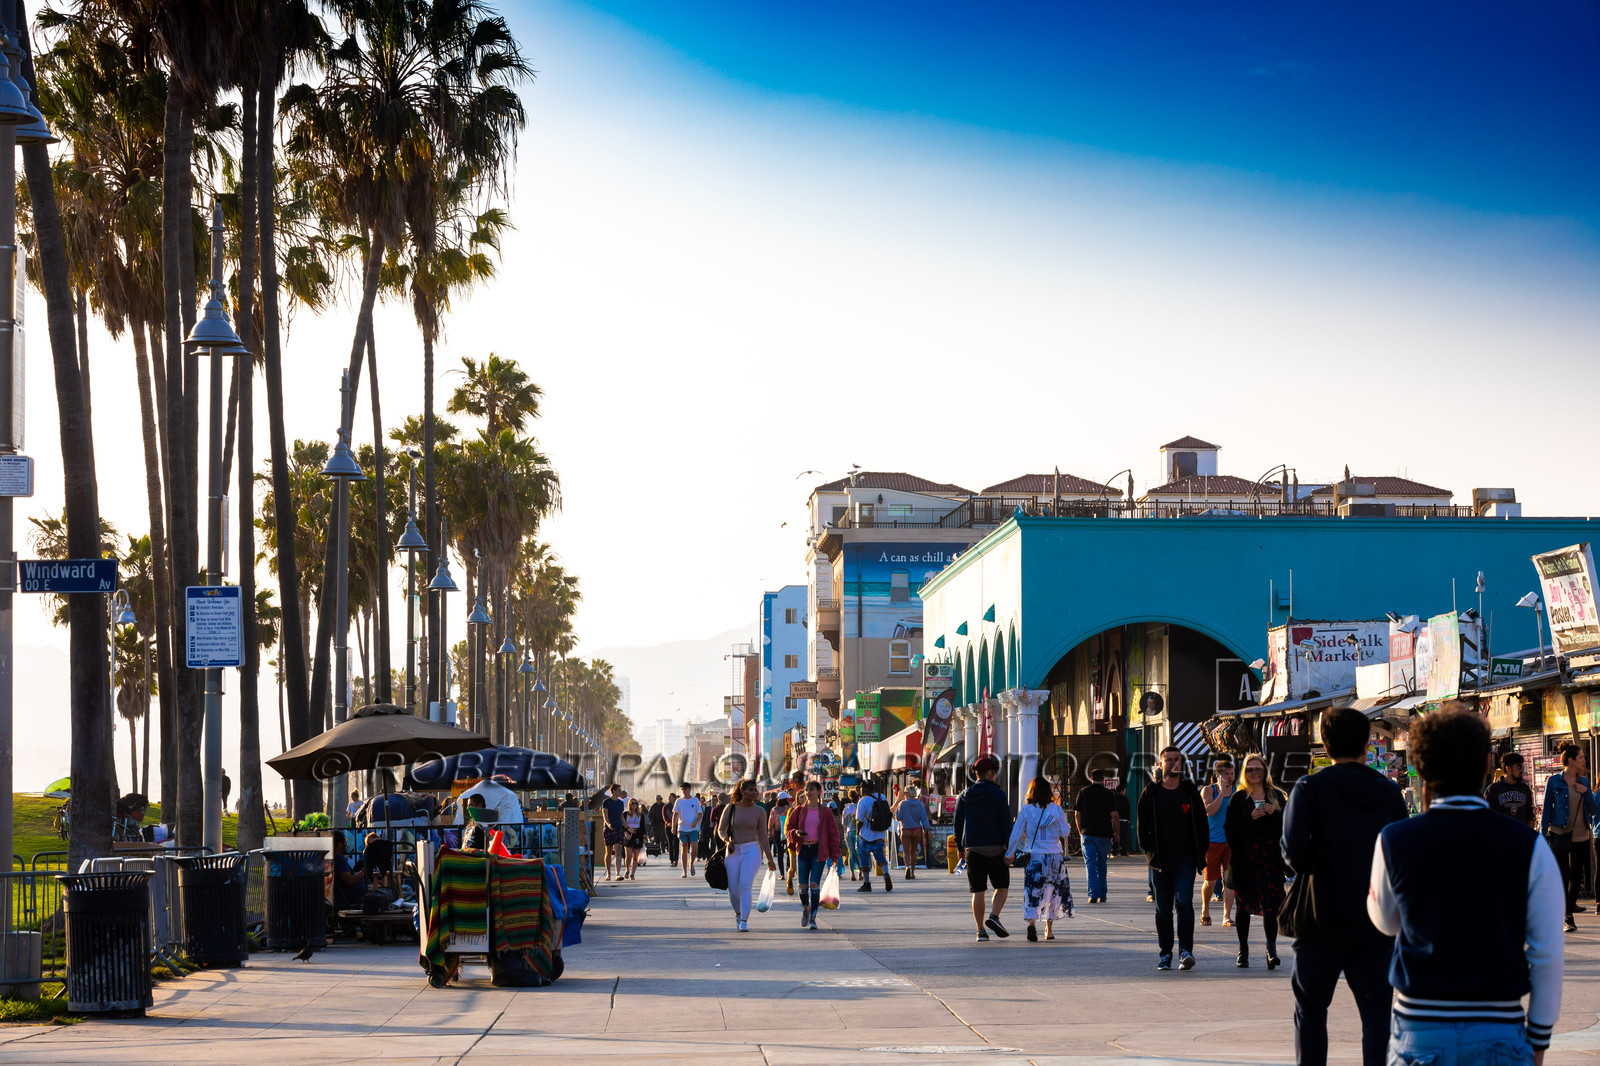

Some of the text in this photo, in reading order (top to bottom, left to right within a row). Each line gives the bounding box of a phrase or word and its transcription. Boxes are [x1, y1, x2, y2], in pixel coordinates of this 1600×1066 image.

[879, 551, 888, 562] A
[922, 552, 944, 562] chill
[25, 562, 95, 579] Windward
[44, 580, 50, 590] E
[98, 578, 111, 590] Av
[1309, 648, 1367, 662] Market
[1494, 664, 1520, 674] ATM
[823, 780, 840, 791] toe
